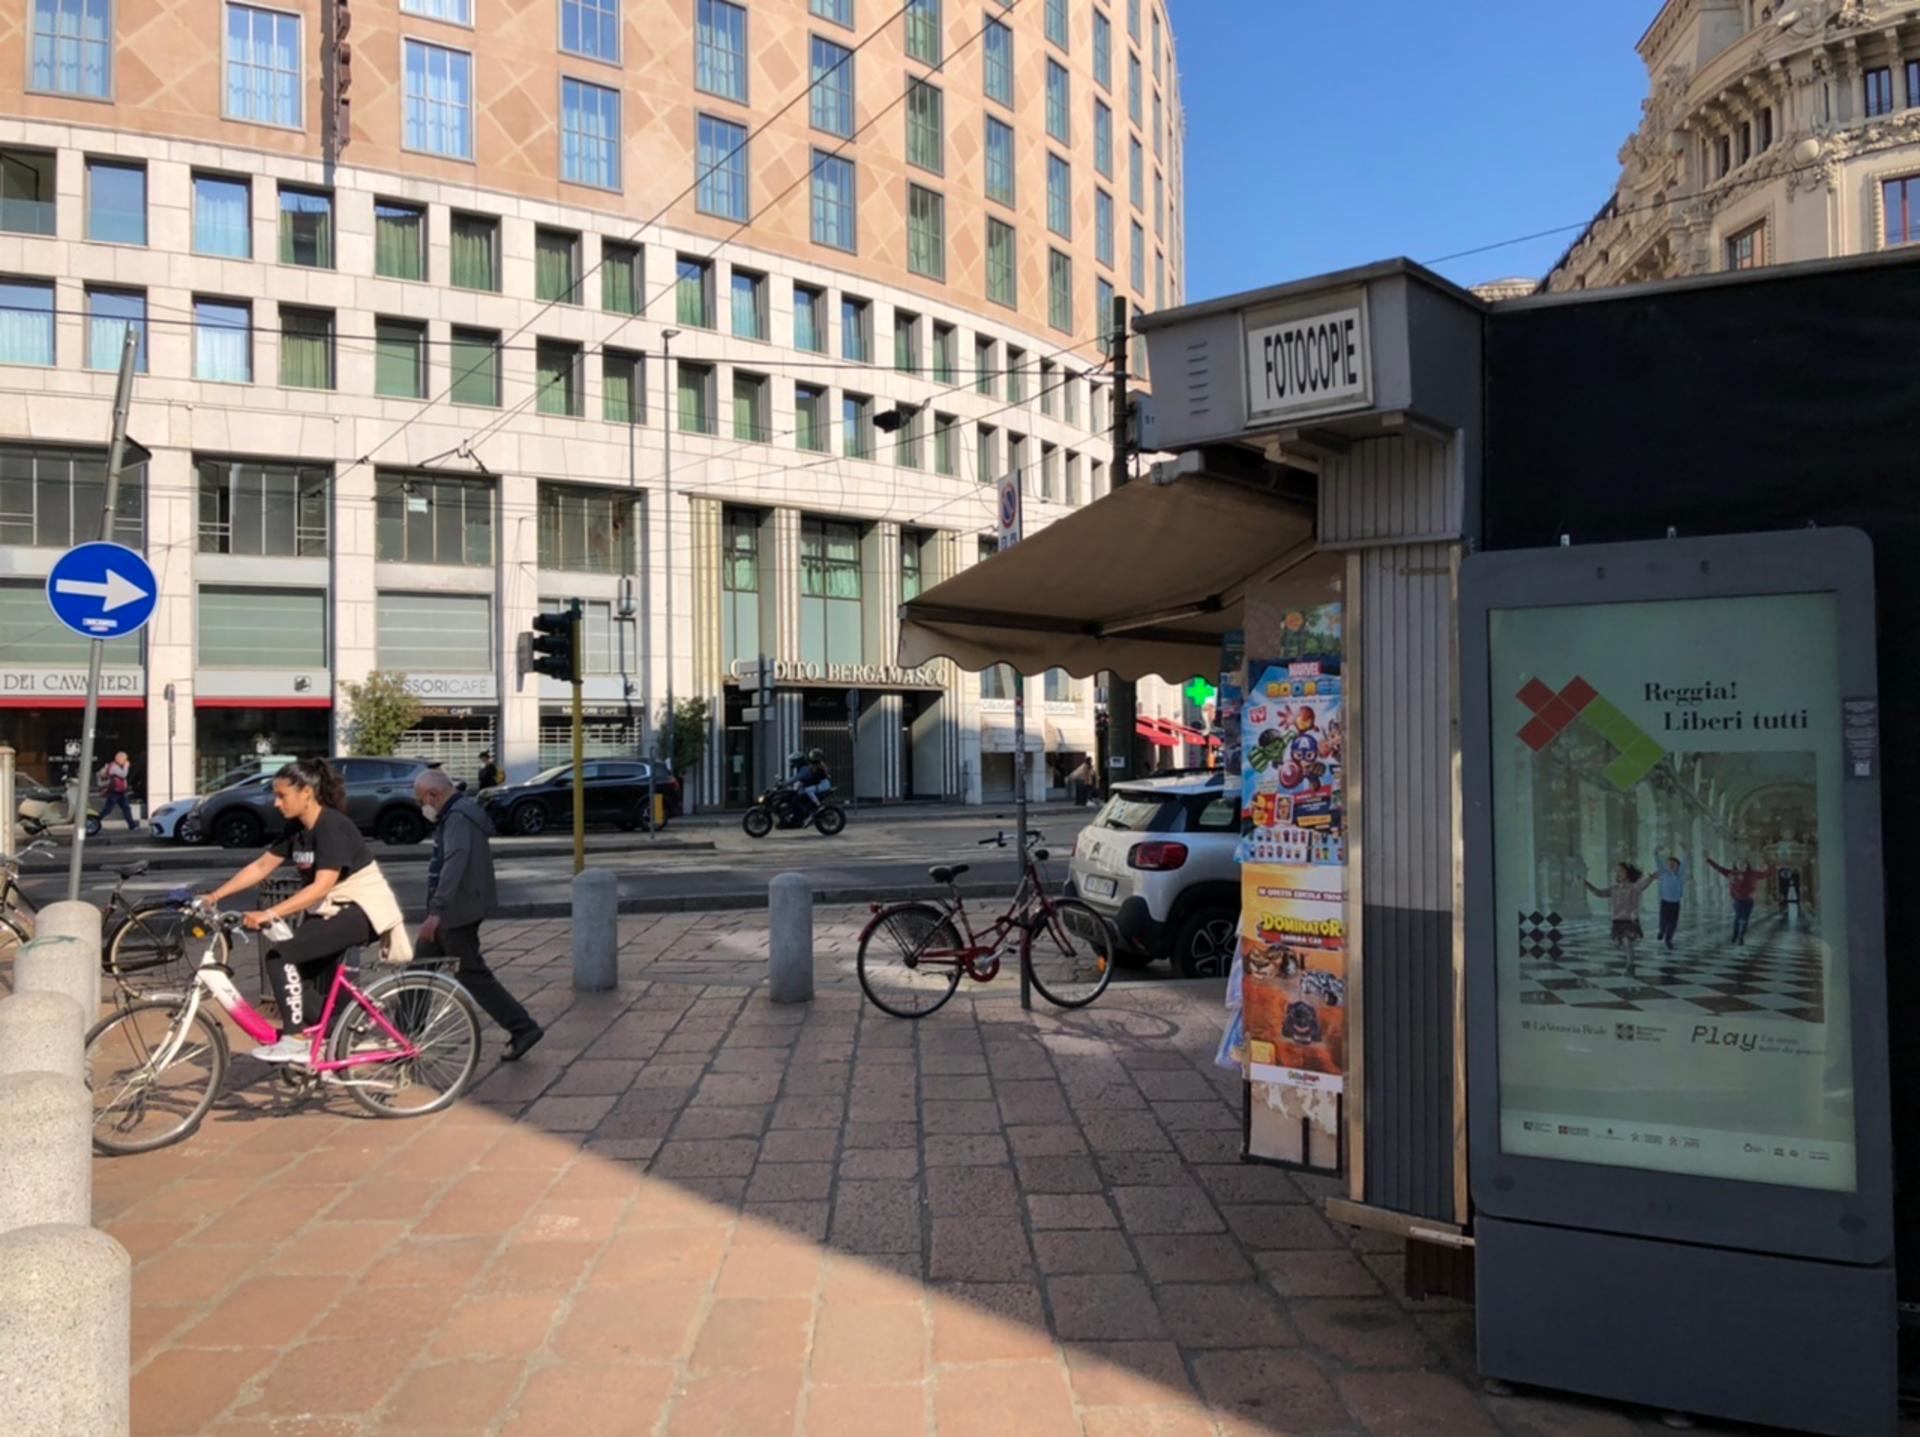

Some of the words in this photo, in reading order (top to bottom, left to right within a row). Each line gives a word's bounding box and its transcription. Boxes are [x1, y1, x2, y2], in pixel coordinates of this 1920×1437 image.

[1264, 318, 1357, 400] FOTOCOPIE
[3, 674, 35, 690] DEI
[827, 661, 948, 686] BERGAMASCO
[1644, 681, 1737, 707] Reggia!
[1664, 710, 1743, 730] Liberi
[1753, 709, 1809, 730] tutti
[1262, 911, 1343, 937] DOMINATOR
[284, 963, 303, 1024] adidas
[1691, 1025, 1757, 1052] Play
